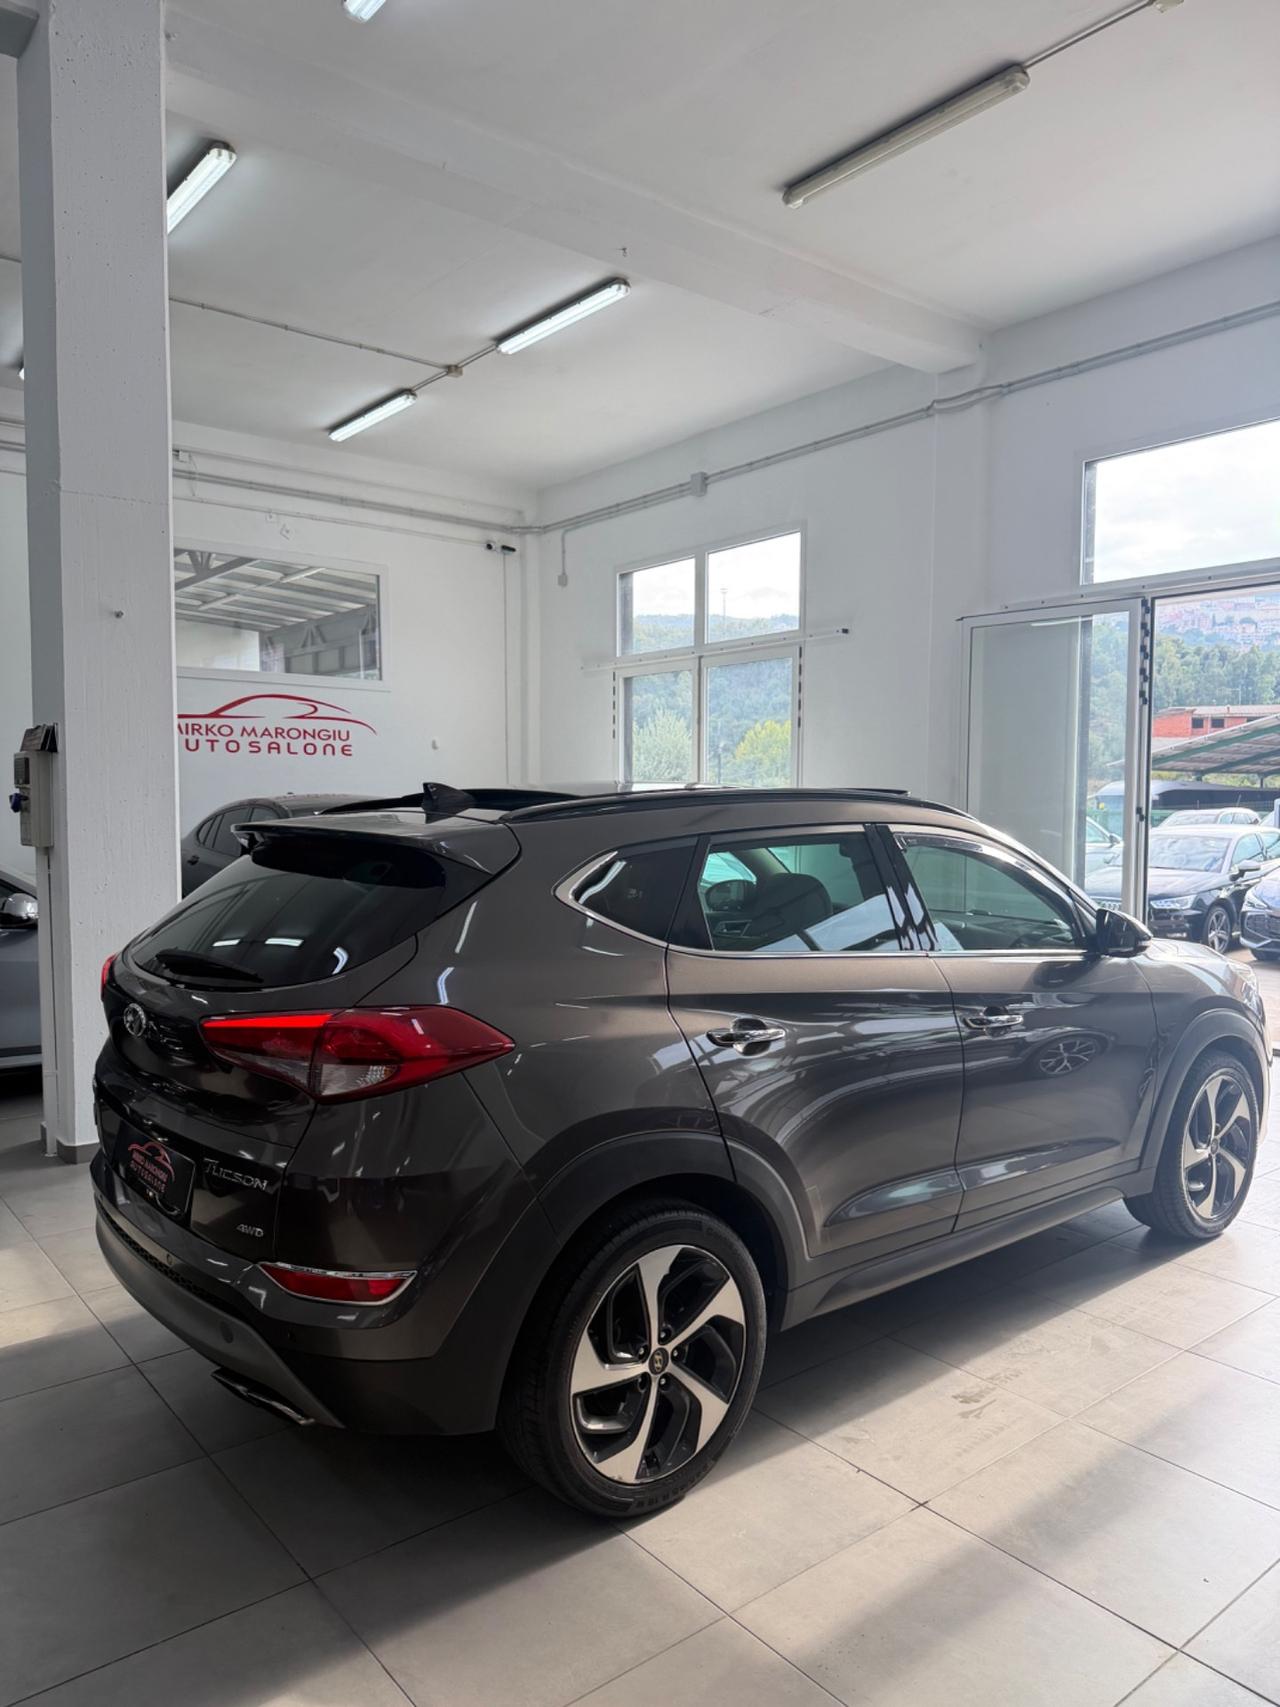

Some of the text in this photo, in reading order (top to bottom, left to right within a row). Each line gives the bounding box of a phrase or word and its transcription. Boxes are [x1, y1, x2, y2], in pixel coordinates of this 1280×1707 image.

[240, 726, 350, 742] MARONGIU
[184, 738, 353, 756] UTOSALONE
[203, 1158, 268, 1191] TUCSON
[236, 1223, 264, 1237] 4WD
